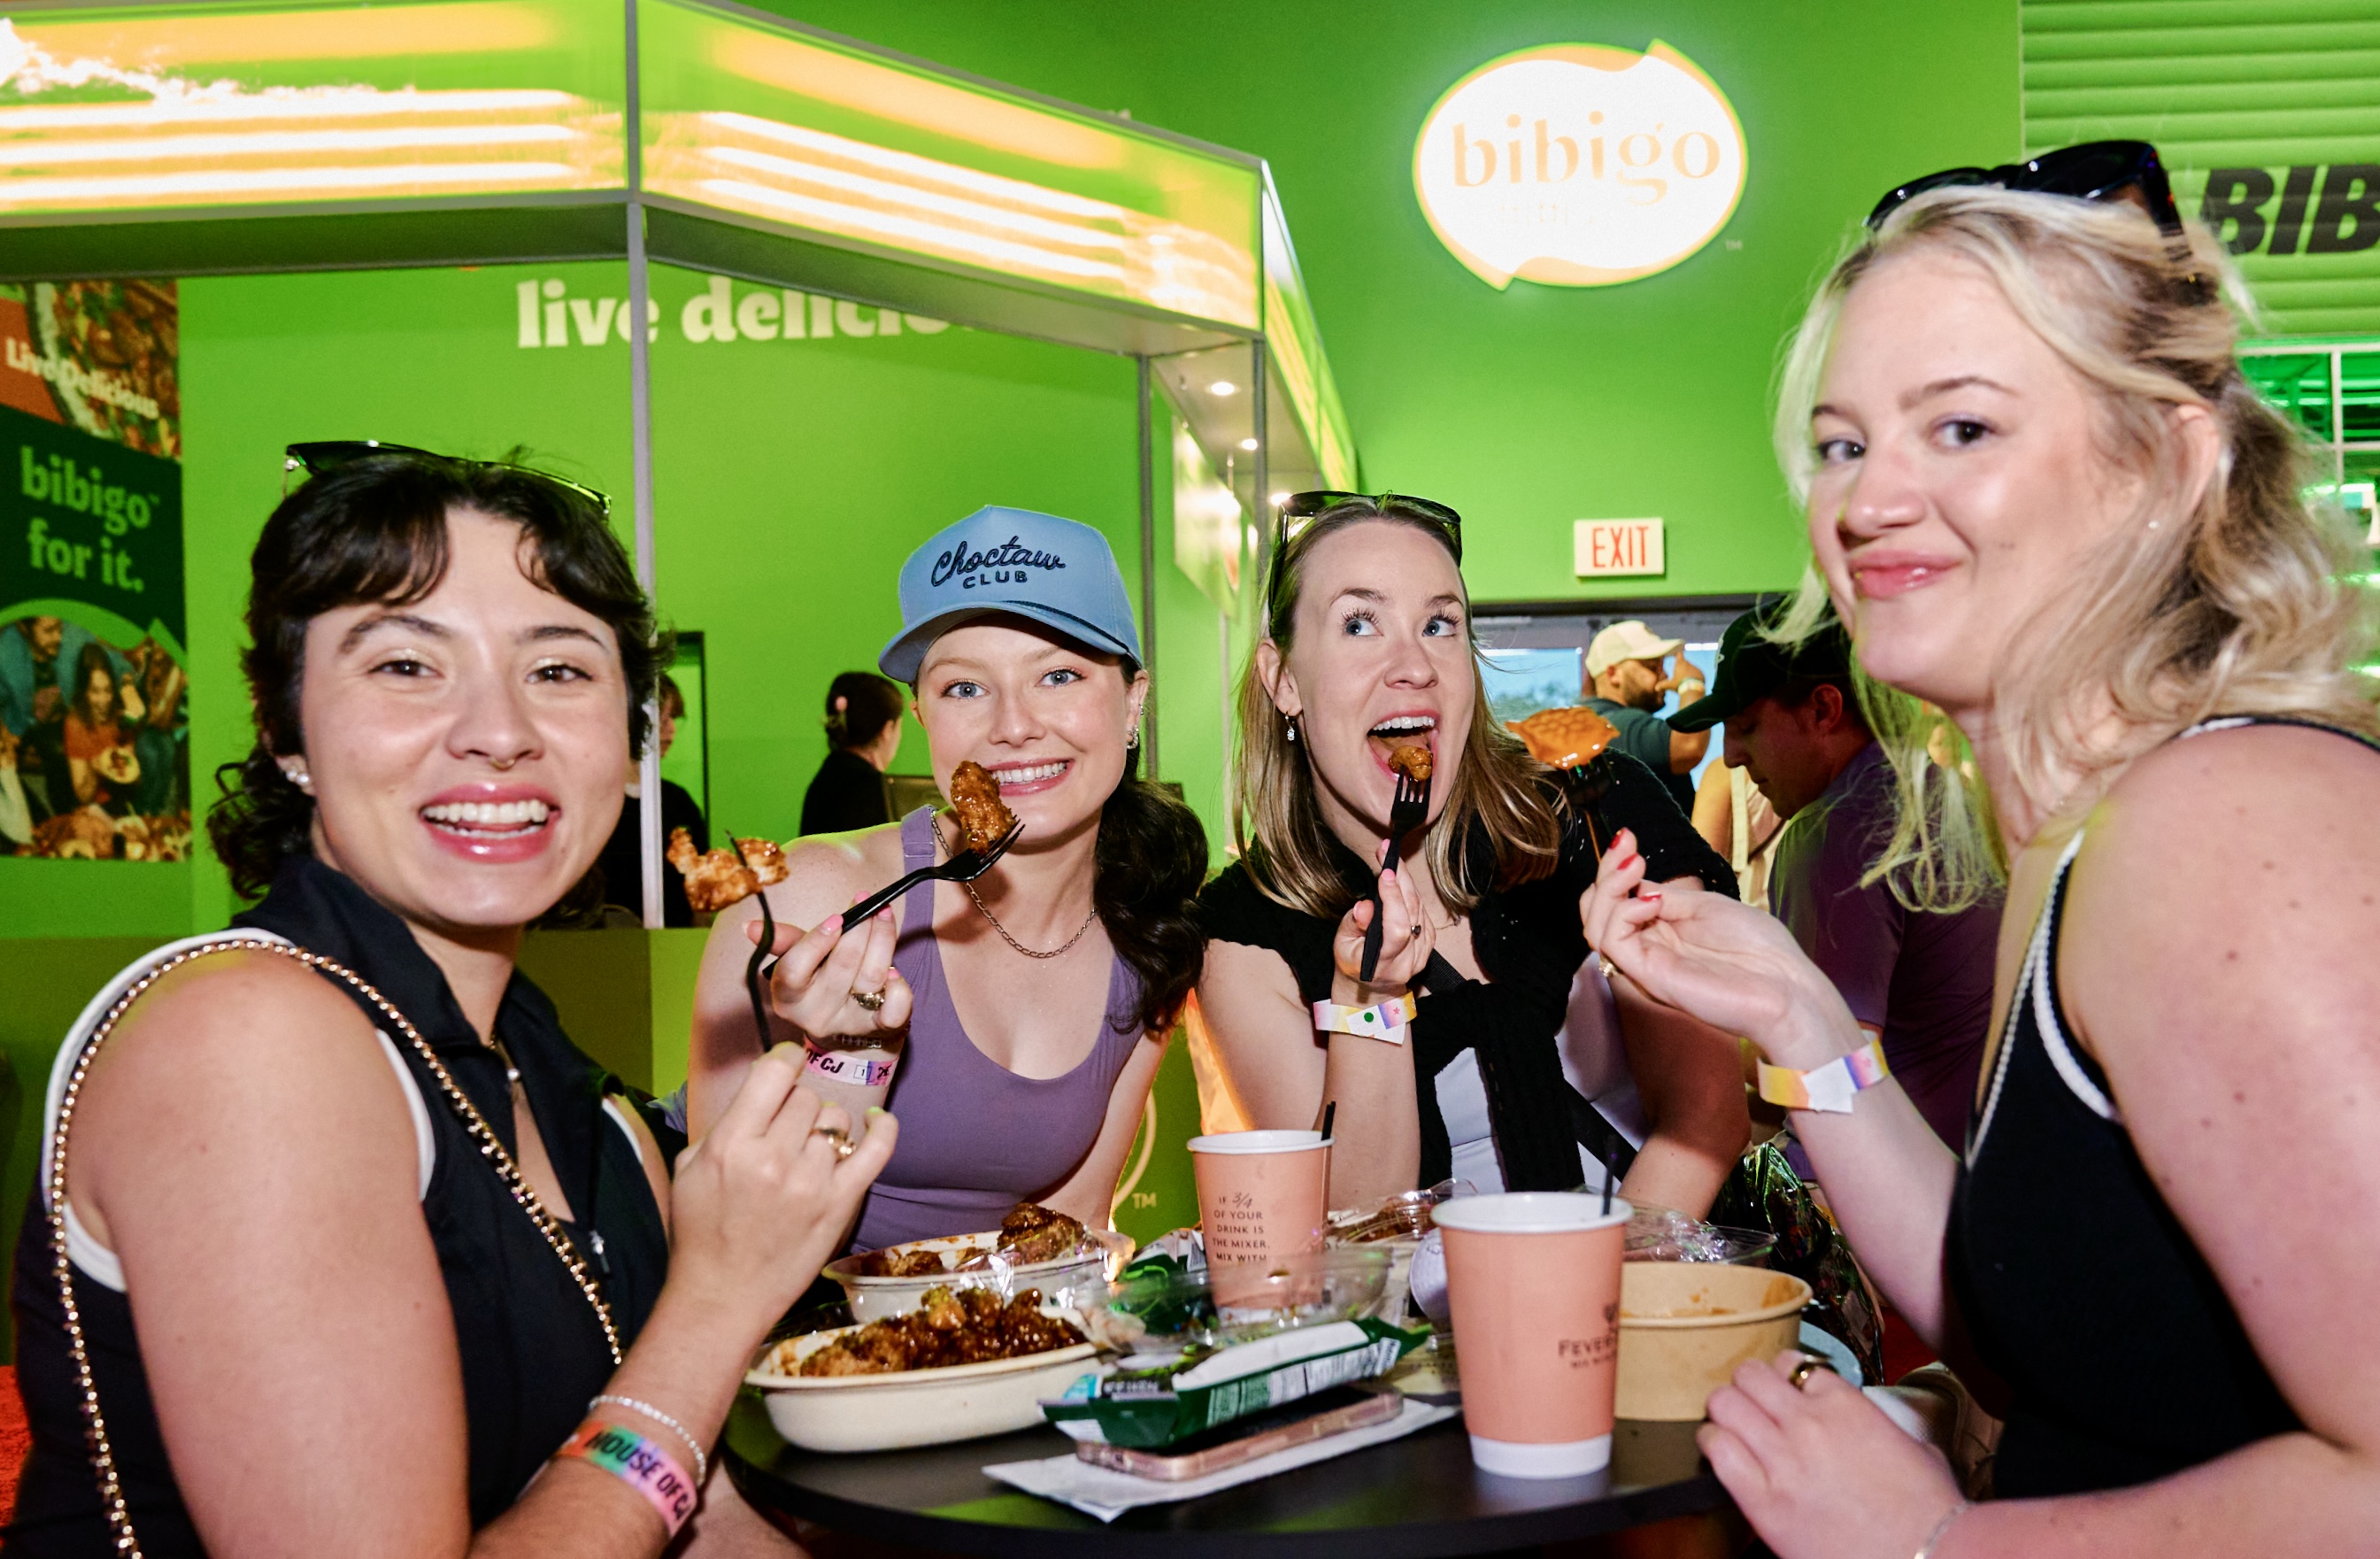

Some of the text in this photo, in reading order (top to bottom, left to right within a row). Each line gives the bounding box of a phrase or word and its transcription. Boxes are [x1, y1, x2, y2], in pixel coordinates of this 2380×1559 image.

[1452, 110, 1721, 206] bibigo
[2199, 163, 2380, 256] BIB
[517, 278, 660, 349] live
[20, 445, 151, 536] bibigo
[27, 517, 144, 593] for it.
[931, 536, 1066, 587] Choctaw
[1592, 527, 1648, 567] EXIT
[963, 570, 1028, 589] CLUB
[820, 1057, 844, 1074] CJ
[1131, 1192, 1157, 1208] TM
[1213, 1209, 1263, 1219] OF YOUR
[1213, 1237, 1228, 1247] THE
[1217, 1224, 1264, 1234] DRINK IS
[1216, 1252, 1232, 1262] MIX
[584, 1429, 663, 1480] HOUSE
[657, 1473, 683, 1498] OF
